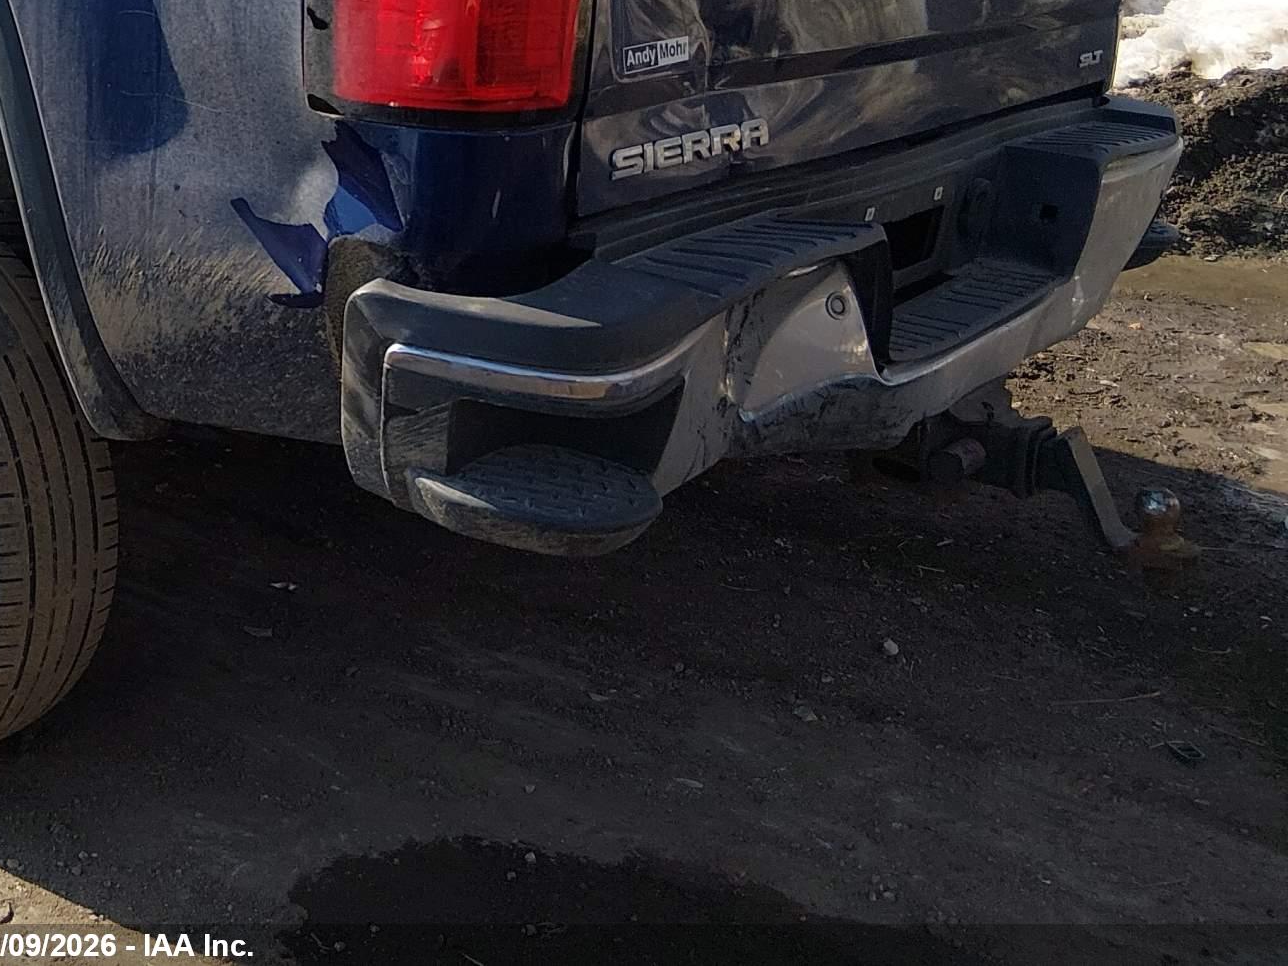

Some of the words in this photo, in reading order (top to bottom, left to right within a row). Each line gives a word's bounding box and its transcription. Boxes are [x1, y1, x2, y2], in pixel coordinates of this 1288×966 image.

[626, 45, 657, 67] Andy
[658, 40, 687, 60] Mohr
[1079, 49, 1103, 68] SLT
[611, 118, 769, 180] SIERRA
